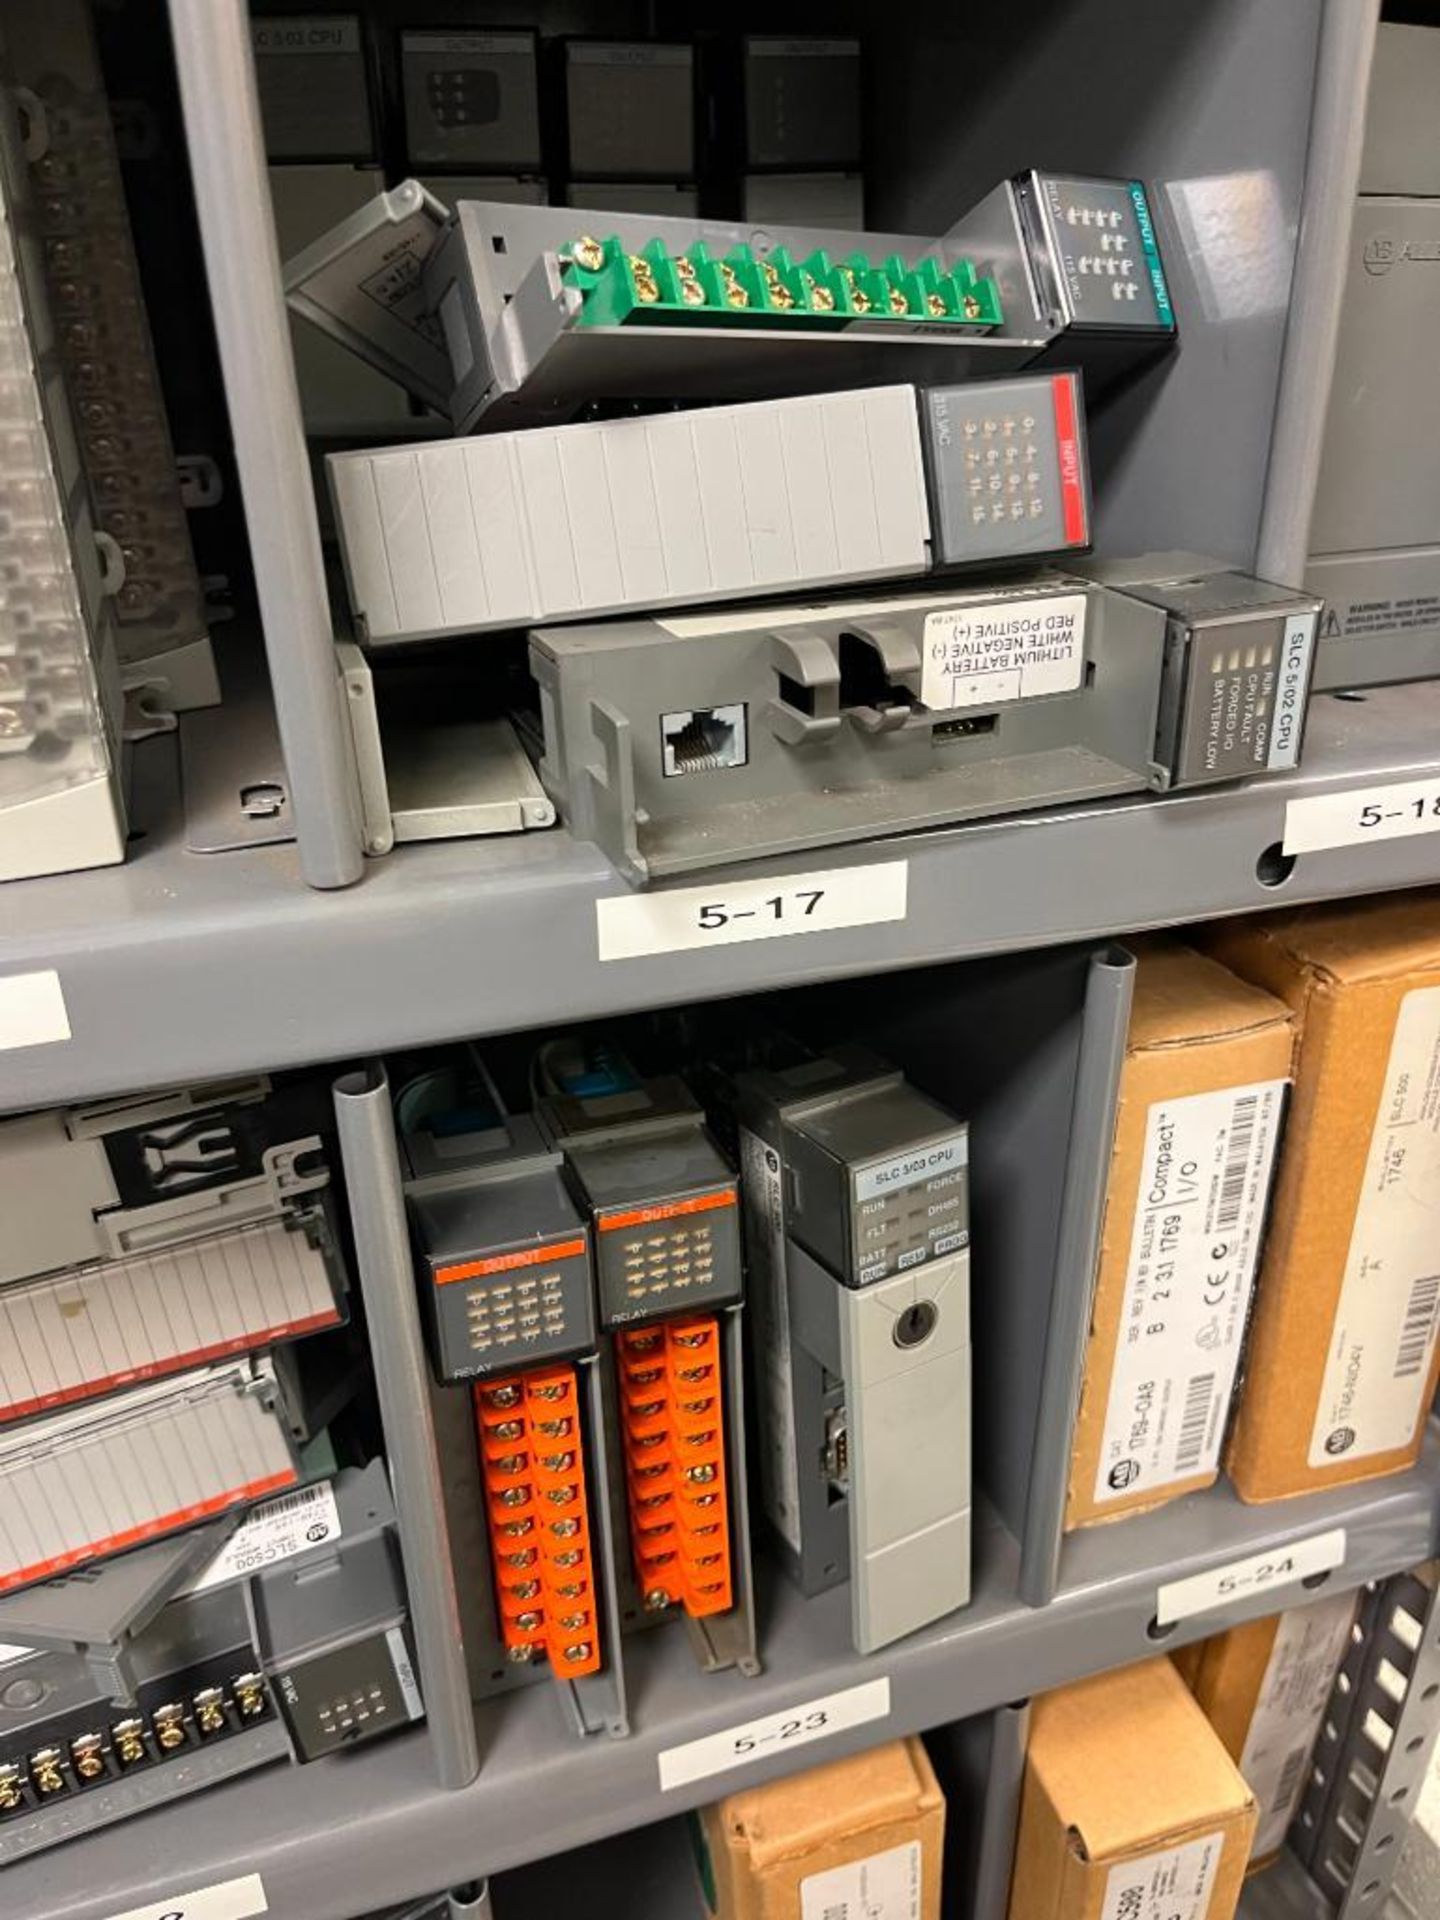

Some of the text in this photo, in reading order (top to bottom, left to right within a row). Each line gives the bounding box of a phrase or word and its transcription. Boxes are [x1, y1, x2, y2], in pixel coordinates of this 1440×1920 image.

[308, 29, 343, 46] CPU
[1132, 191, 1169, 311] OUTPUT INPUT
[1070, 276, 1082, 300] VAC
[1059, 440, 1079, 485] INPUT
[932, 632, 1073, 659] WHITE NEGATIVE (-)
[953, 614, 1075, 642] RED POSITIVE (+)
[942, 647, 1072, 675] LITHIUM BATTERY
[1262, 671, 1274, 696] RUN
[1276, 632, 1304, 751] SLC 5/02 CPU
[1226, 677, 1241, 731] FORCED
[1240, 673, 1258, 743] CPU FAULT
[1205, 679, 1225, 769] BATTERY LOW
[698, 890, 825, 930] 5-17
[875, 1166, 901, 1185] SLC
[928, 1147, 954, 1166] CPU
[1176, 1161, 1199, 1193] I/O
[862, 1172, 963, 1216] RUN FORCE
[1159, 1214, 1181, 1253] 1769
[1152, 1289, 1170, 1301] 2
[1217, 1557, 1293, 1595] 5-24
[734, 1711, 828, 1754] 5-23
